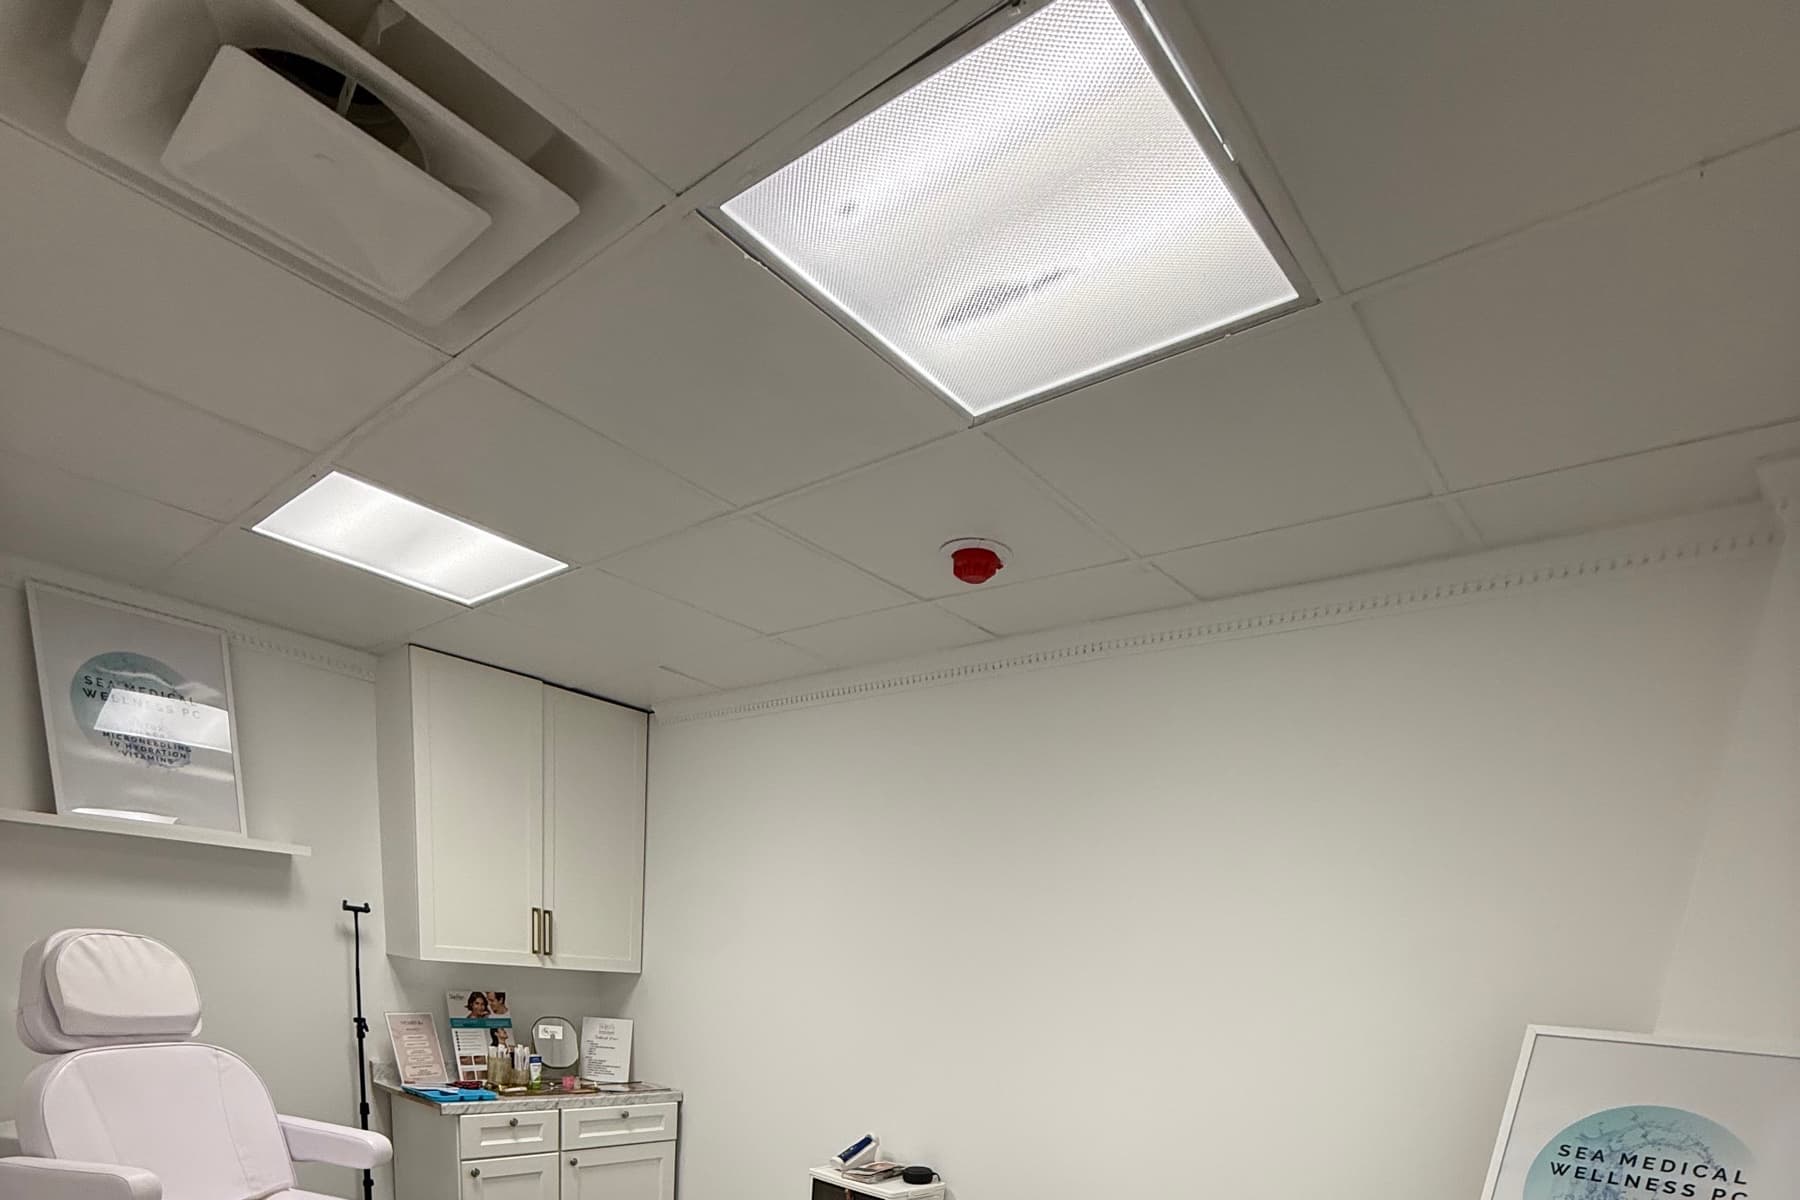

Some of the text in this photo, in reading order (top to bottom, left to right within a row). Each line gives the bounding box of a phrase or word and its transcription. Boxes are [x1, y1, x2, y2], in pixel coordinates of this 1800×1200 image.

[84, 675, 116, 689] SEA
[1550, 1161, 1696, 1198] WELLNESS
[1558, 1144, 1748, 1185] SEA MEDICAL
